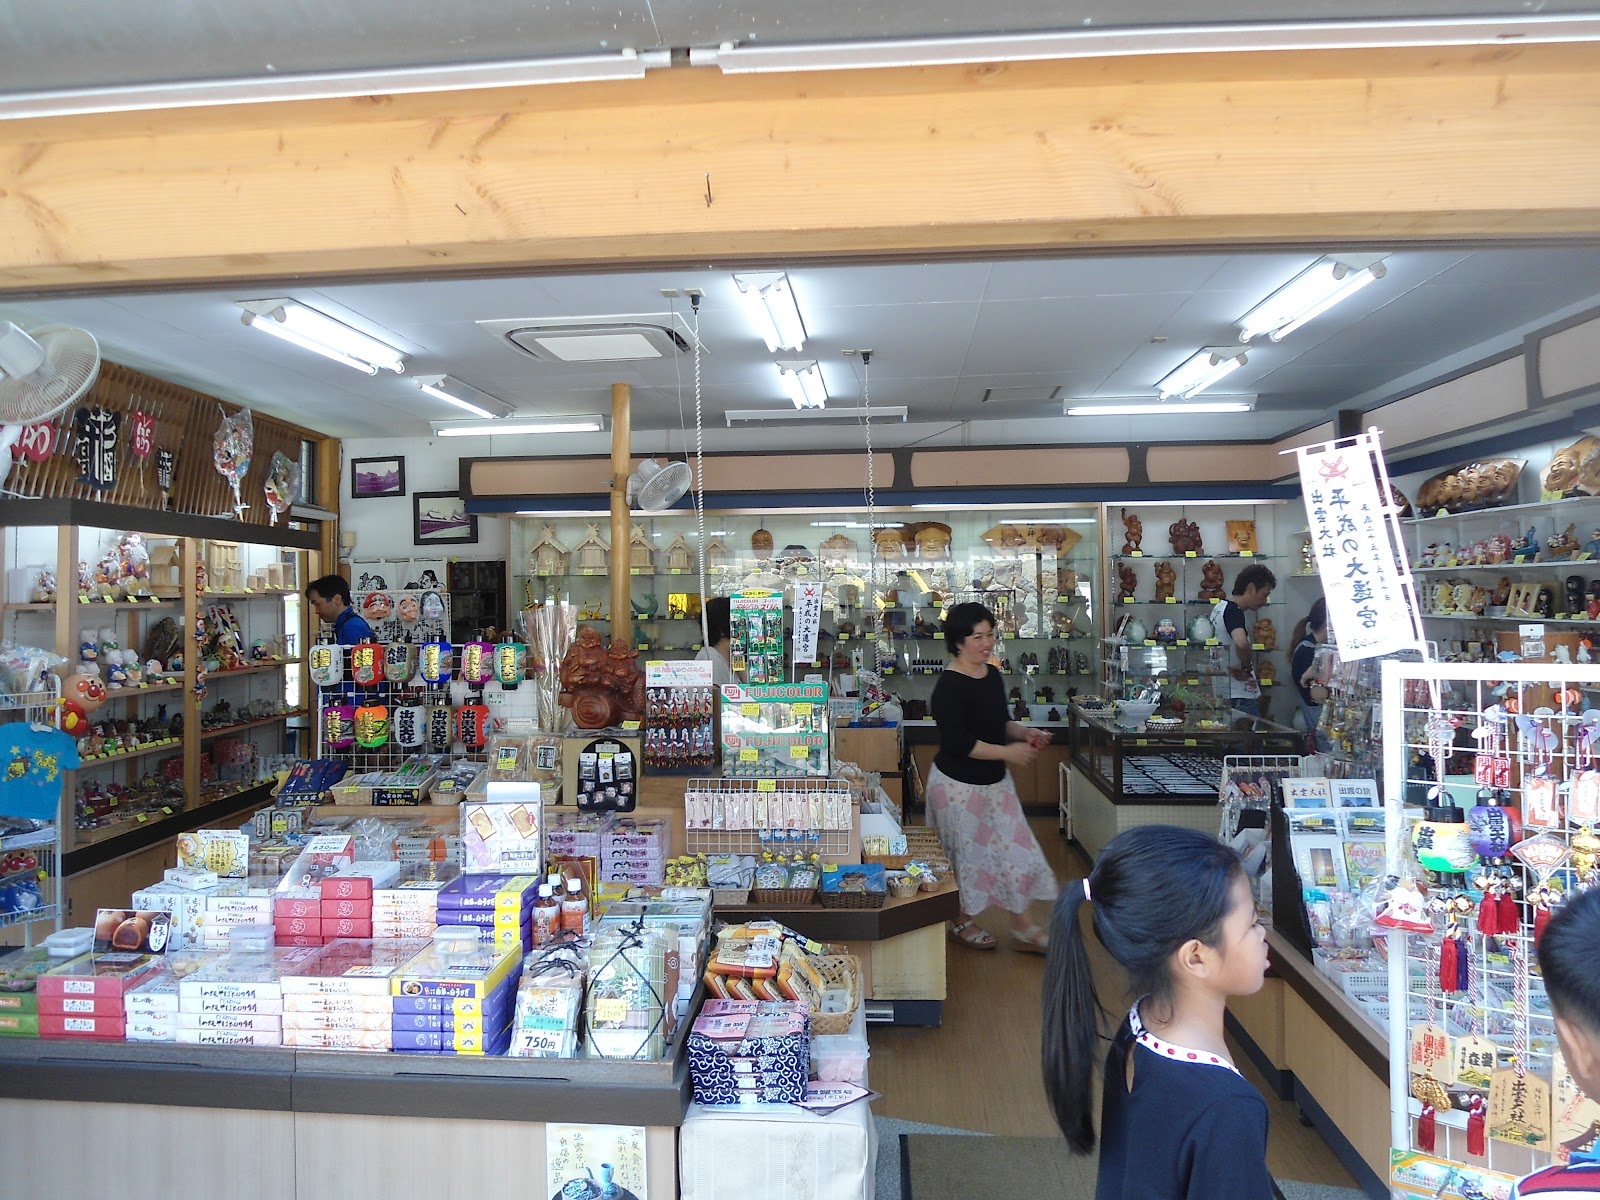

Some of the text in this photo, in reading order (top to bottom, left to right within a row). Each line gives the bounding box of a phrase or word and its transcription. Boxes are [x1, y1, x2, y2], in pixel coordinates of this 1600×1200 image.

[802, 599, 813, 653] 平成の大遷宮
[745, 687, 823, 698] FUJICOLOR
[400, 709, 415, 745] 出雲大社
[432, 709, 447, 745] 出雲大社
[461, 709, 477, 745] 出雲大社
[745, 736, 824, 747] FUJICOLOR
[1291, 787, 1328, 797] 出雲大社
[1338, 786, 1371, 796] 出雲の旅
[524, 1035, 556, 1050] 750円
[1509, 1079, 1529, 1124] 出雲大社
